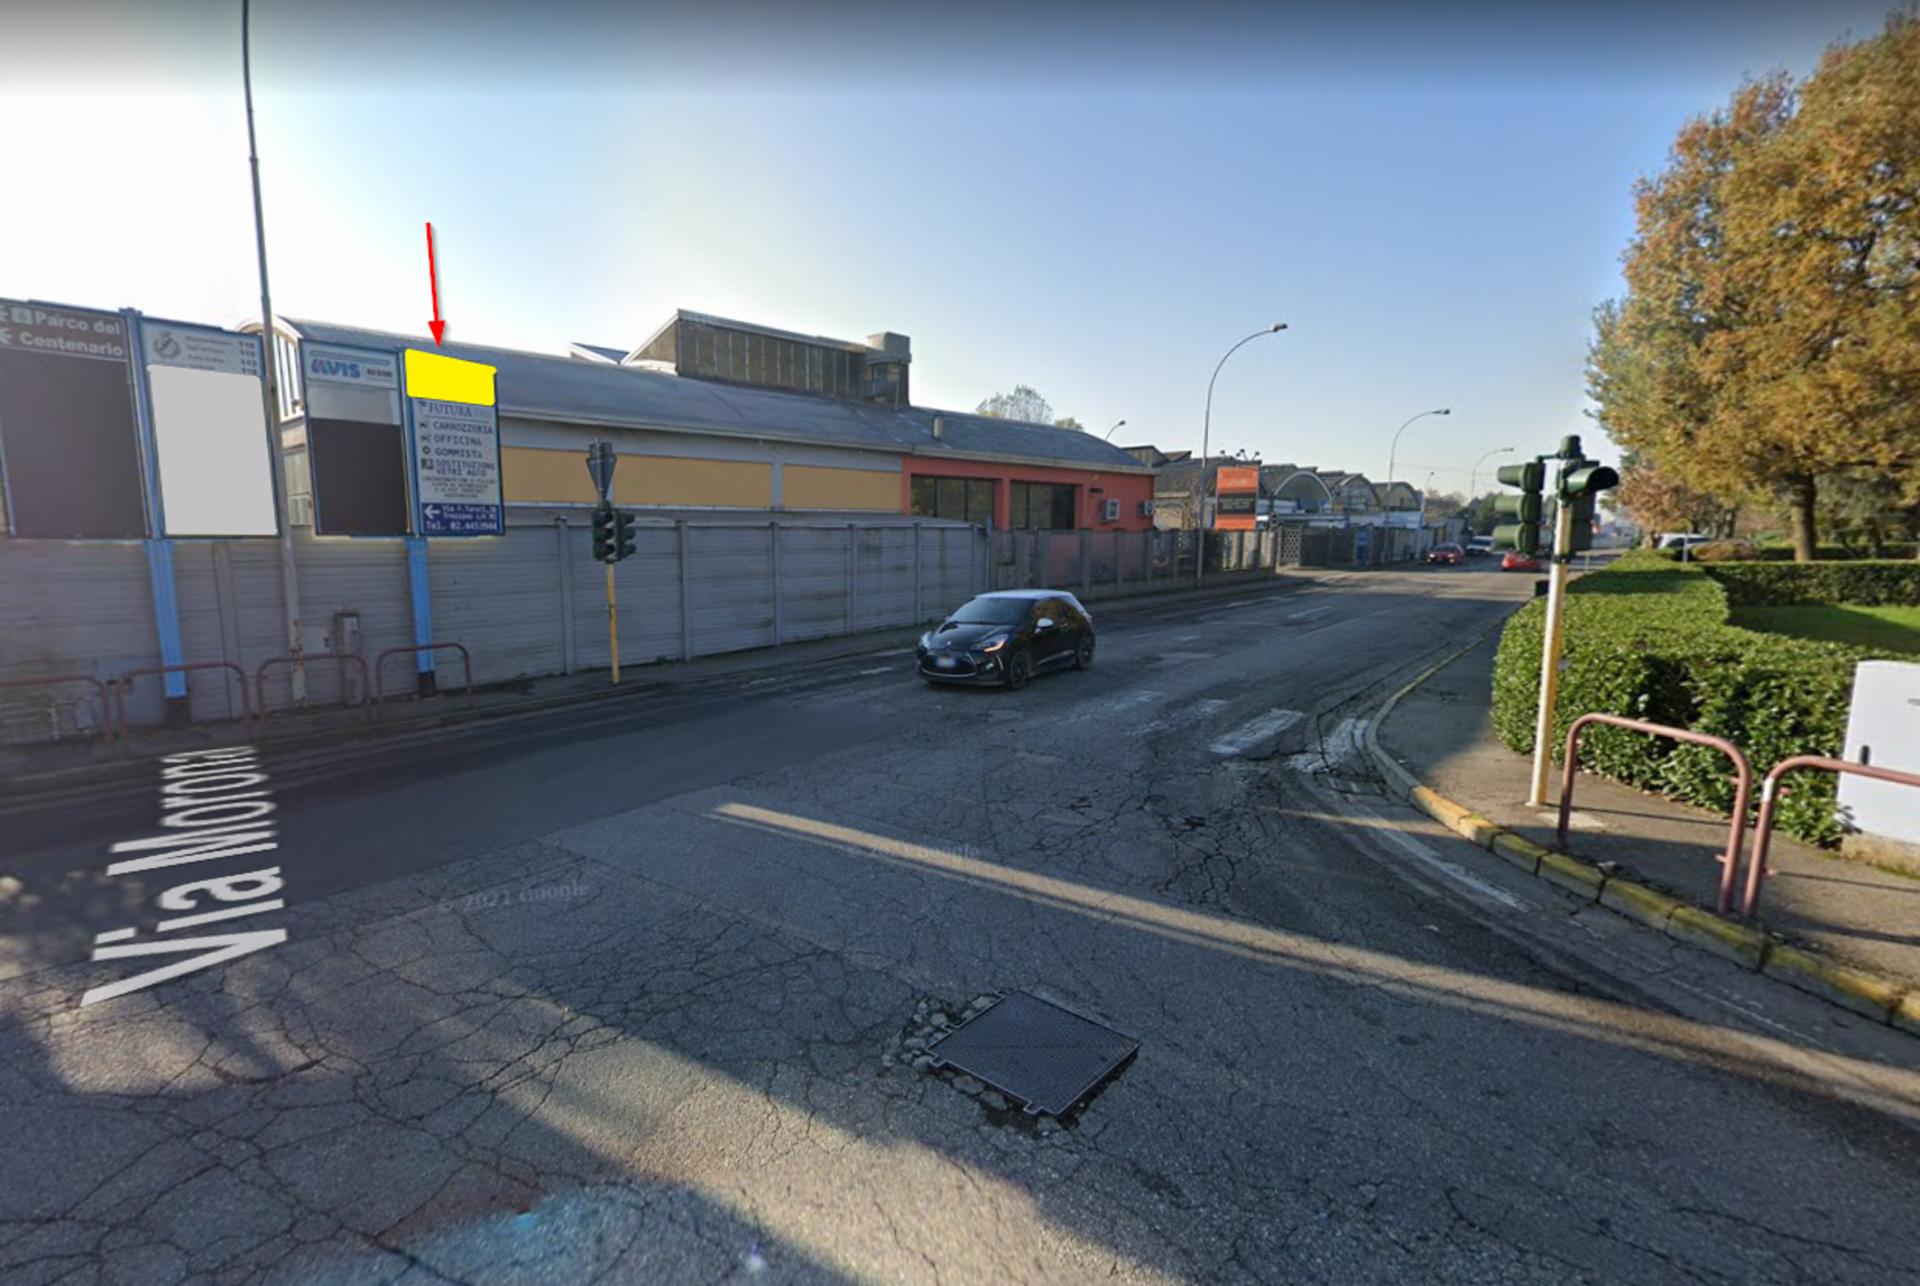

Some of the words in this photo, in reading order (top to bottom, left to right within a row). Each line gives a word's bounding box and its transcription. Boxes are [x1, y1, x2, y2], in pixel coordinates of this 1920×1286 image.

[35, 310, 88, 331] Parco
[94, 321, 120, 335] del
[20, 331, 123, 356] Centenario
[311, 357, 361, 378] AVIS
[433, 420, 493, 434] CARROZZERIA
[433, 434, 483, 446] OFFICINA
[435, 447, 483, 458] GOMMISTA
